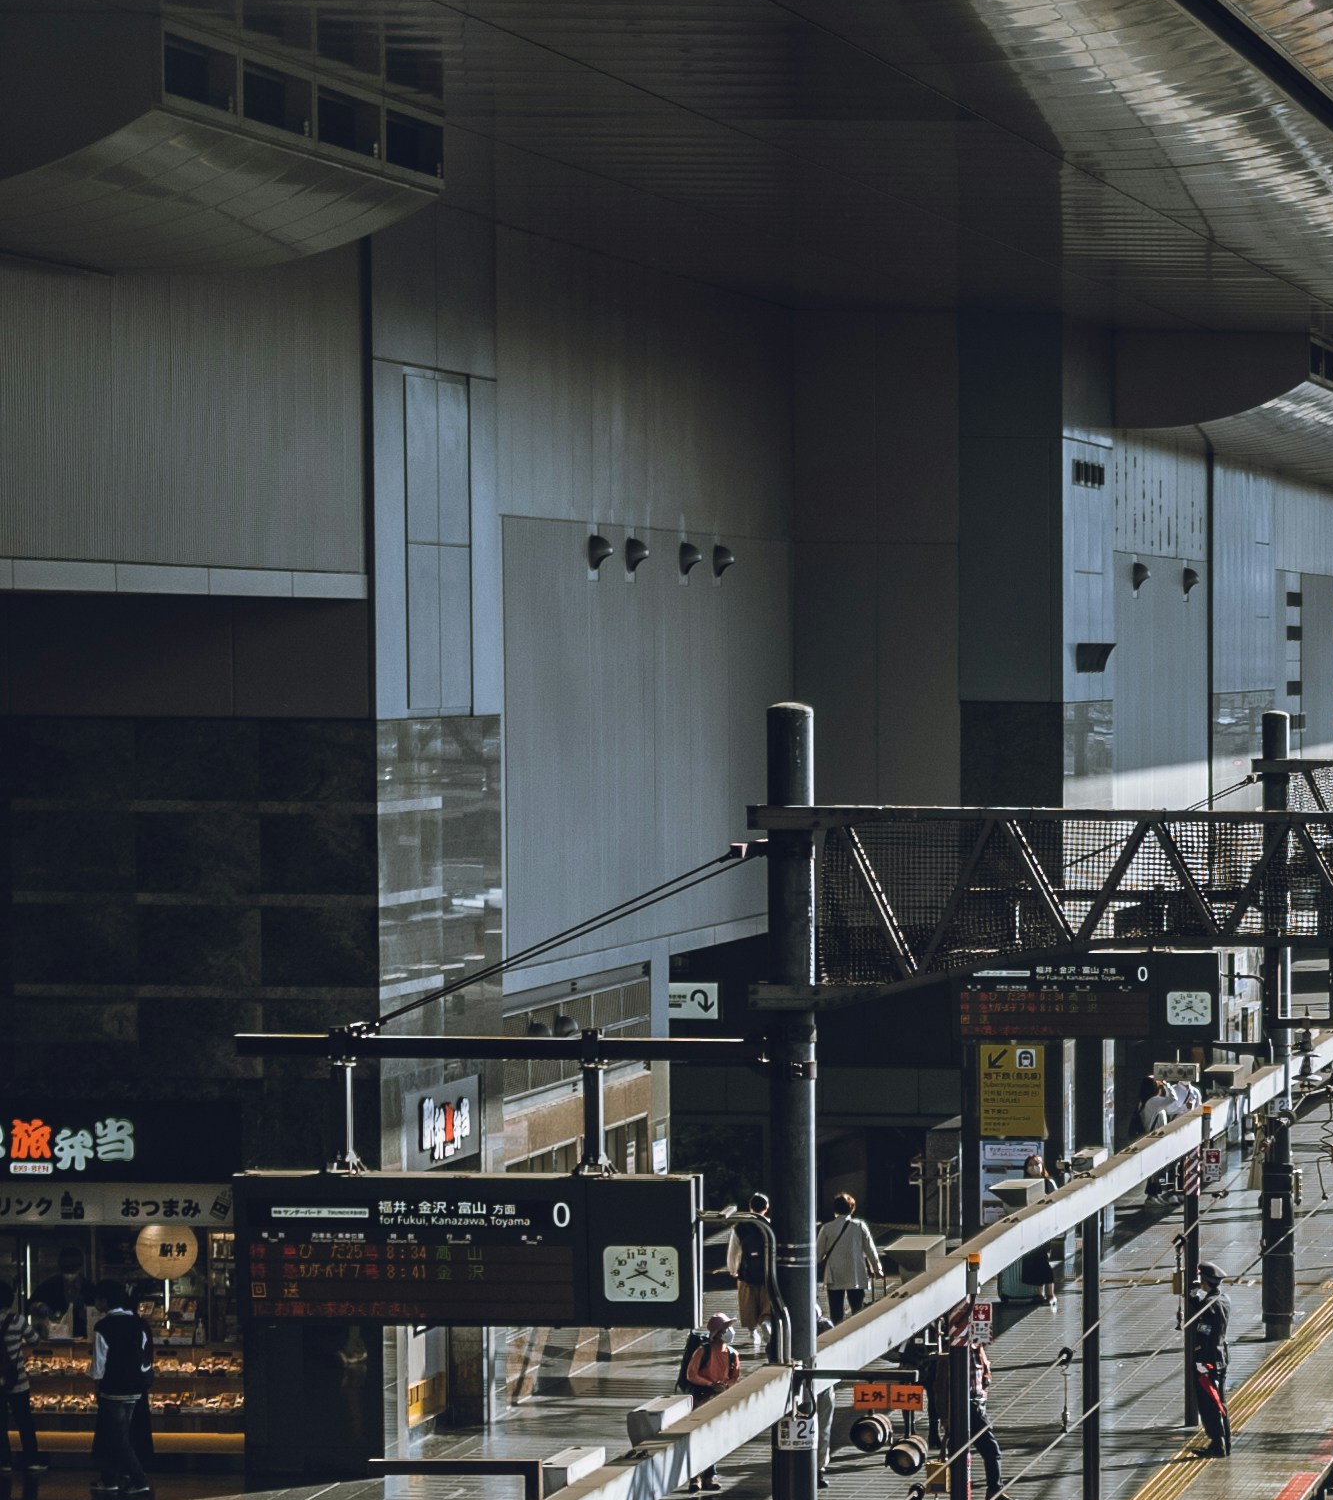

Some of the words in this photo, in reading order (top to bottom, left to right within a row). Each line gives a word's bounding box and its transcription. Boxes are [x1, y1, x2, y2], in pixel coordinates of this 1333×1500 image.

[1137, 966, 1148, 981] 0
[0, 1117, 136, 1172] 旅弁当
[121, 1198, 201, 1219] おつまみ
[378, 1201, 487, 1215] 福井・金沢・富山
[492, 1204, 516, 1215] 方面
[553, 1202, 570, 1228] 0
[379, 1216, 395, 1226] for
[397, 1216, 429, 1227] Fukui,
[431, 1216, 488, 1228] Kanazawa,
[490, 1217, 531, 1228] Toyama
[387, 1245, 427, 1260] 8:34
[387, 1264, 427, 1279] 8:41
[437, 1264, 485, 1280] 金沢
[251, 1281, 300, 1299] 回送
[252, 1301, 427, 1318] にお買い求めください。
[858, 1391, 885, 1403] 上外
[892, 1392, 921, 1404] 上内
